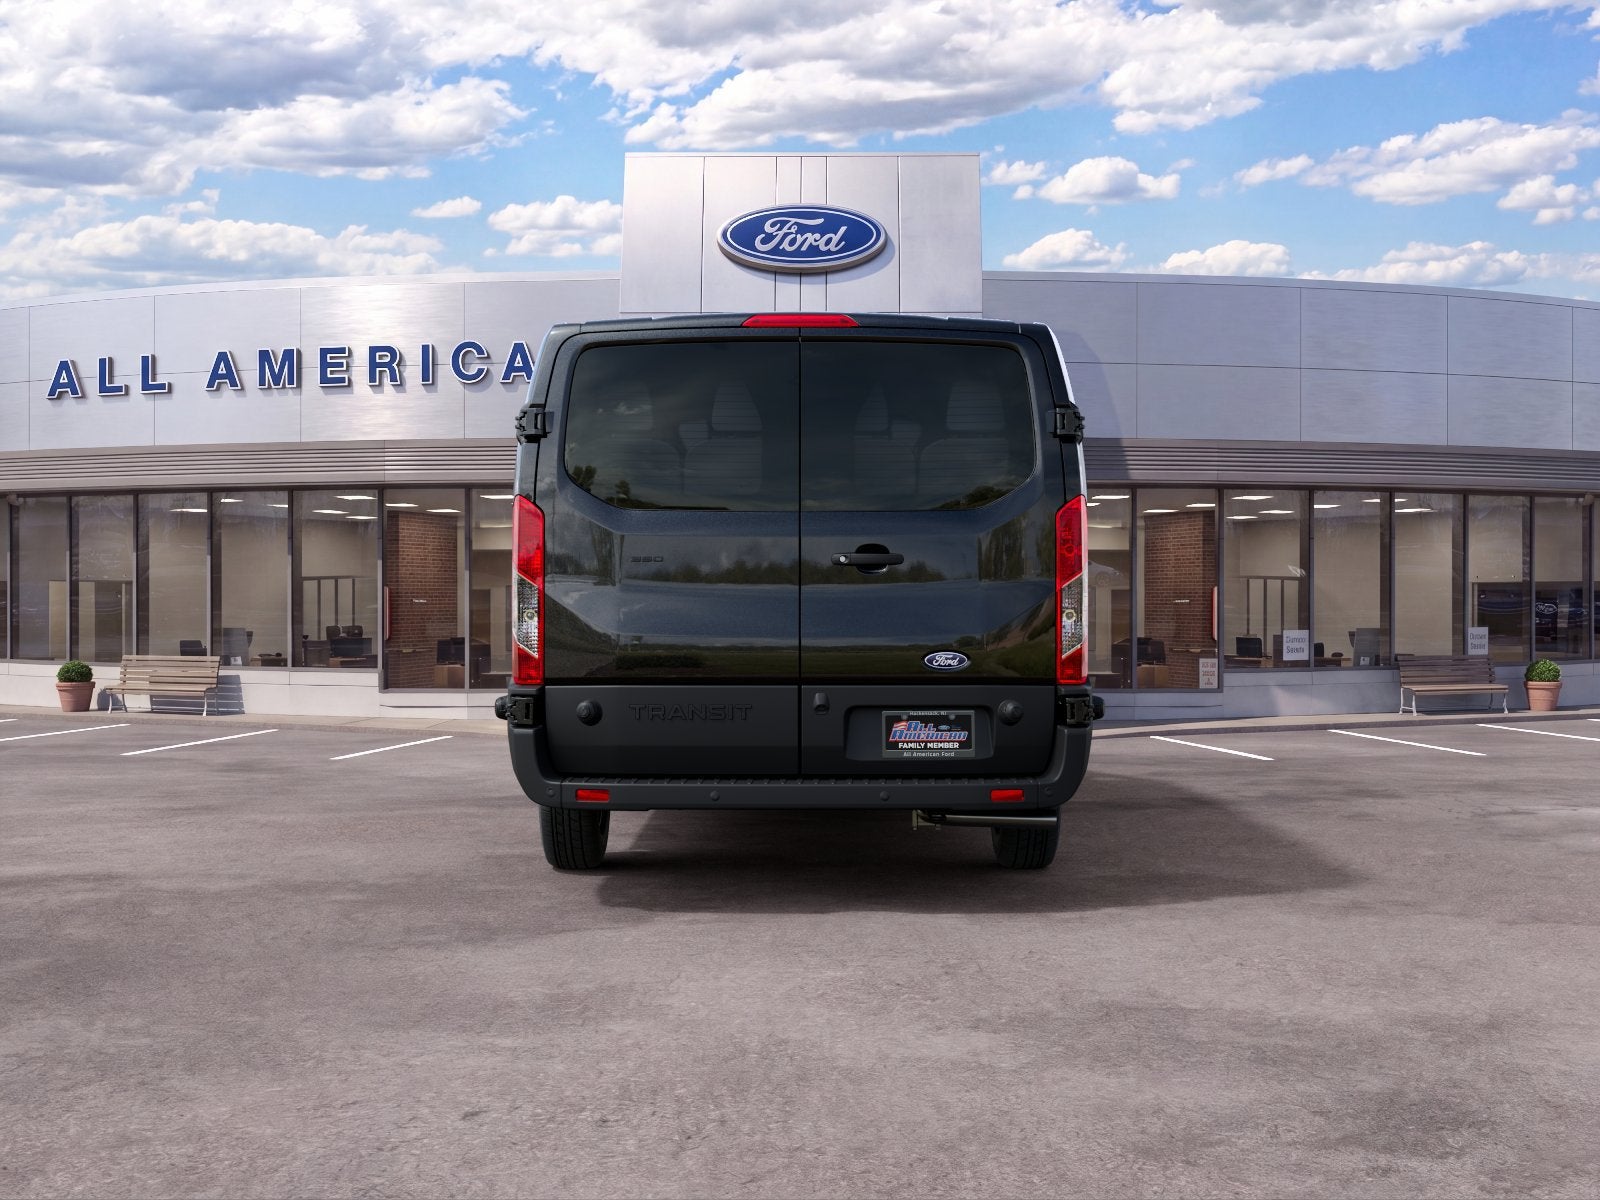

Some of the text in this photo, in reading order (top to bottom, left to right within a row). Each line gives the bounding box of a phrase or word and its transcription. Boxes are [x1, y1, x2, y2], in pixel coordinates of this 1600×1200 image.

[755, 217, 848, 251] Ford
[47, 340, 535, 399] ALL AMERICA
[932, 654, 960, 666] Ford
[628, 703, 753, 721] TRANSIT
